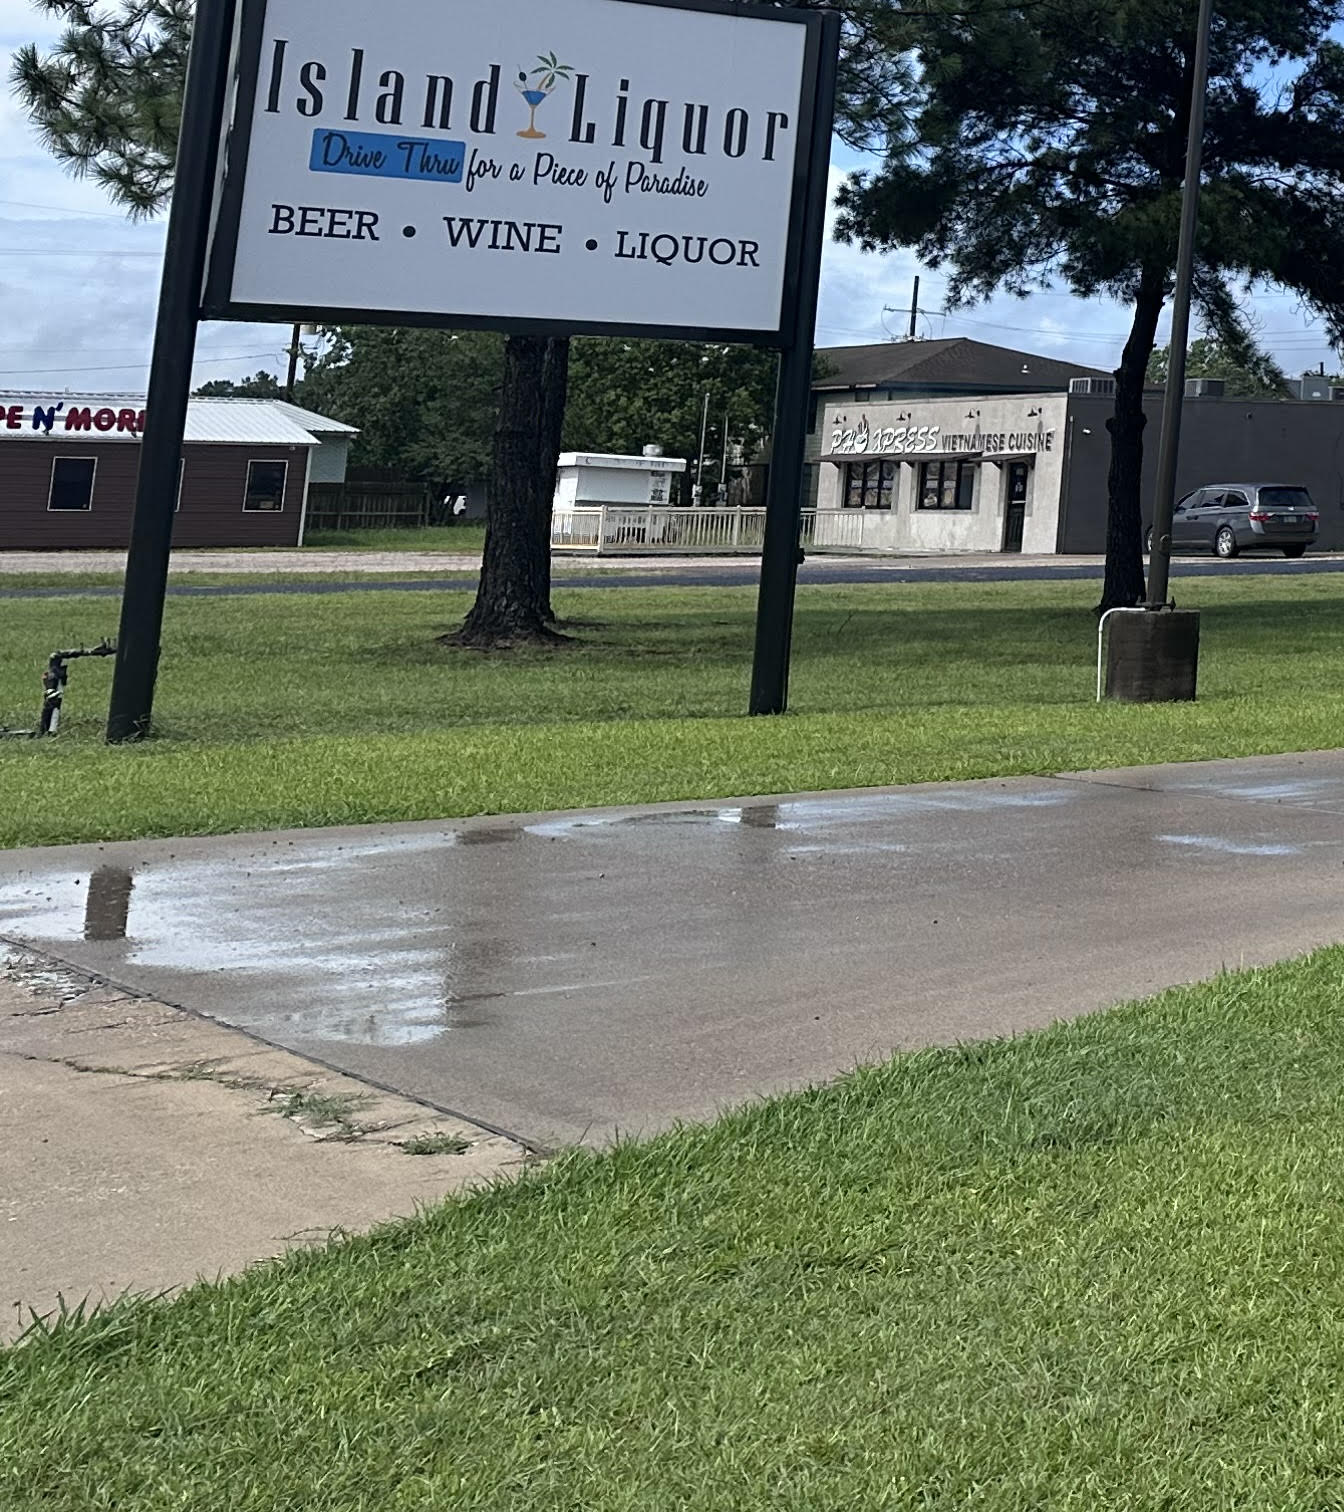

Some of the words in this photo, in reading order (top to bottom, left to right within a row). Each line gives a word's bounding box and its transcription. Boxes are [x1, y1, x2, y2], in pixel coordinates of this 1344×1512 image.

[264, 39, 501, 134] Island
[568, 74, 788, 164] Liquor
[322, 131, 388, 169] Drive
[396, 141, 461, 176] Thru
[465, 148, 501, 192] for
[509, 162, 526, 181] a
[533, 152, 588, 187] Piece
[595, 161, 618, 204] of
[625, 161, 709, 198] Paradise
[268, 204, 380, 241] BEER
[443, 216, 563, 254] WINE
[615, 230, 760, 267] LIQUOR
[872, 426, 940, 454] XPRESS
[942, 433, 1005, 452] VIETNAMESE
[1008, 432, 1053, 452] CUISINE
